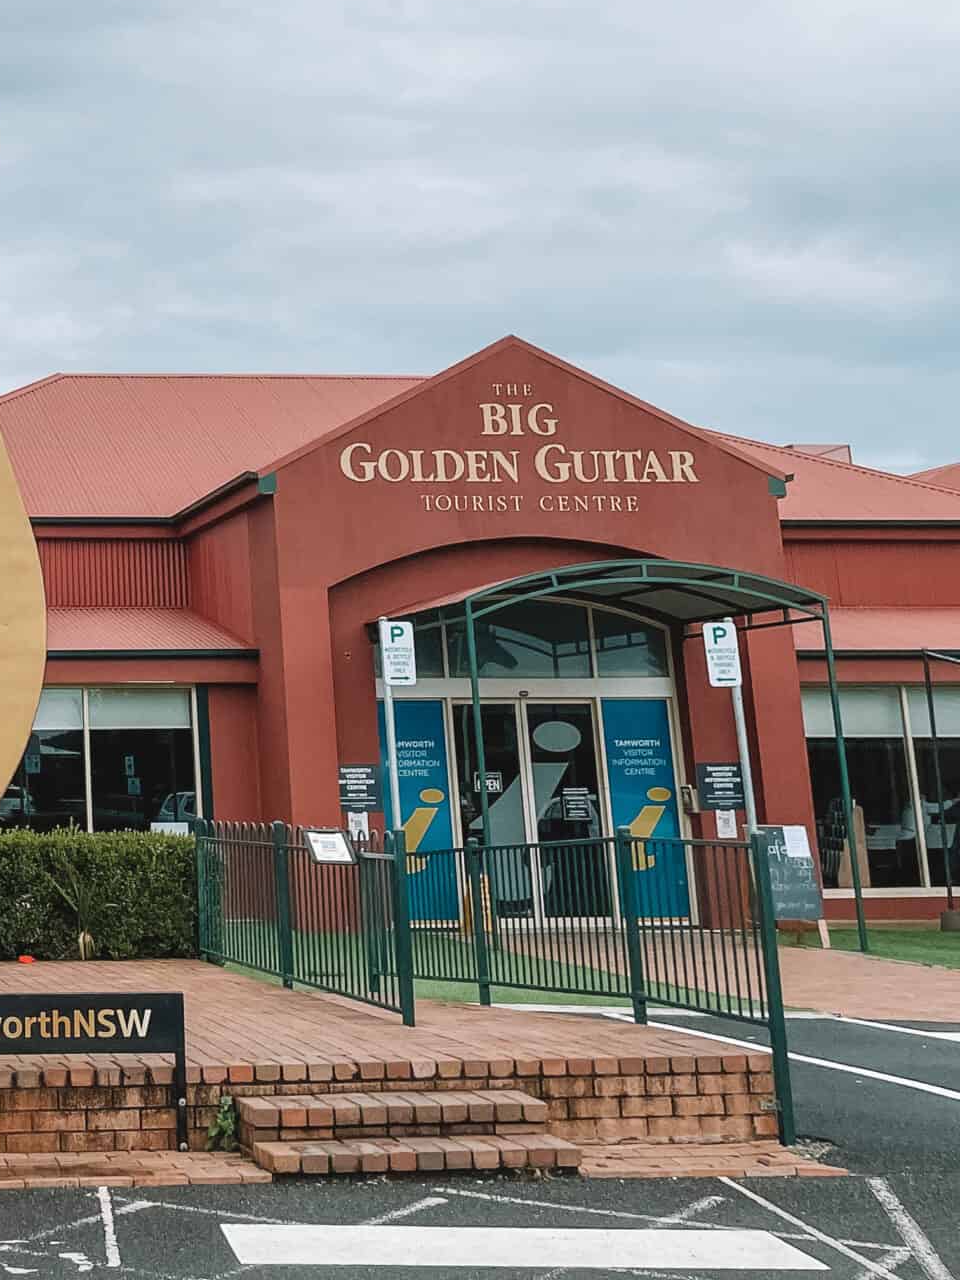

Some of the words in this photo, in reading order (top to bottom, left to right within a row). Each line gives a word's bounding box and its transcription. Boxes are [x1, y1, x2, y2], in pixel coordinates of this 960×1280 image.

[492, 383, 533, 396] THE
[479, 403, 560, 436] BIG
[340, 443, 520, 482] GOLDEN
[535, 443, 700, 482] GUITAR
[421, 495, 523, 511] TOURIST
[539, 495, 640, 512] CENTRE
[390, 626, 404, 643] P
[712, 627, 727, 645] P
[397, 740, 435, 748] MWORTH
[614, 739, 661, 747] TAMWORTH
[622, 749, 654, 757] VISITOR
[385, 759, 440, 768] IORMATION
[612, 758, 667, 766] INFORMATION
[624, 767, 656, 776] CENTRE
